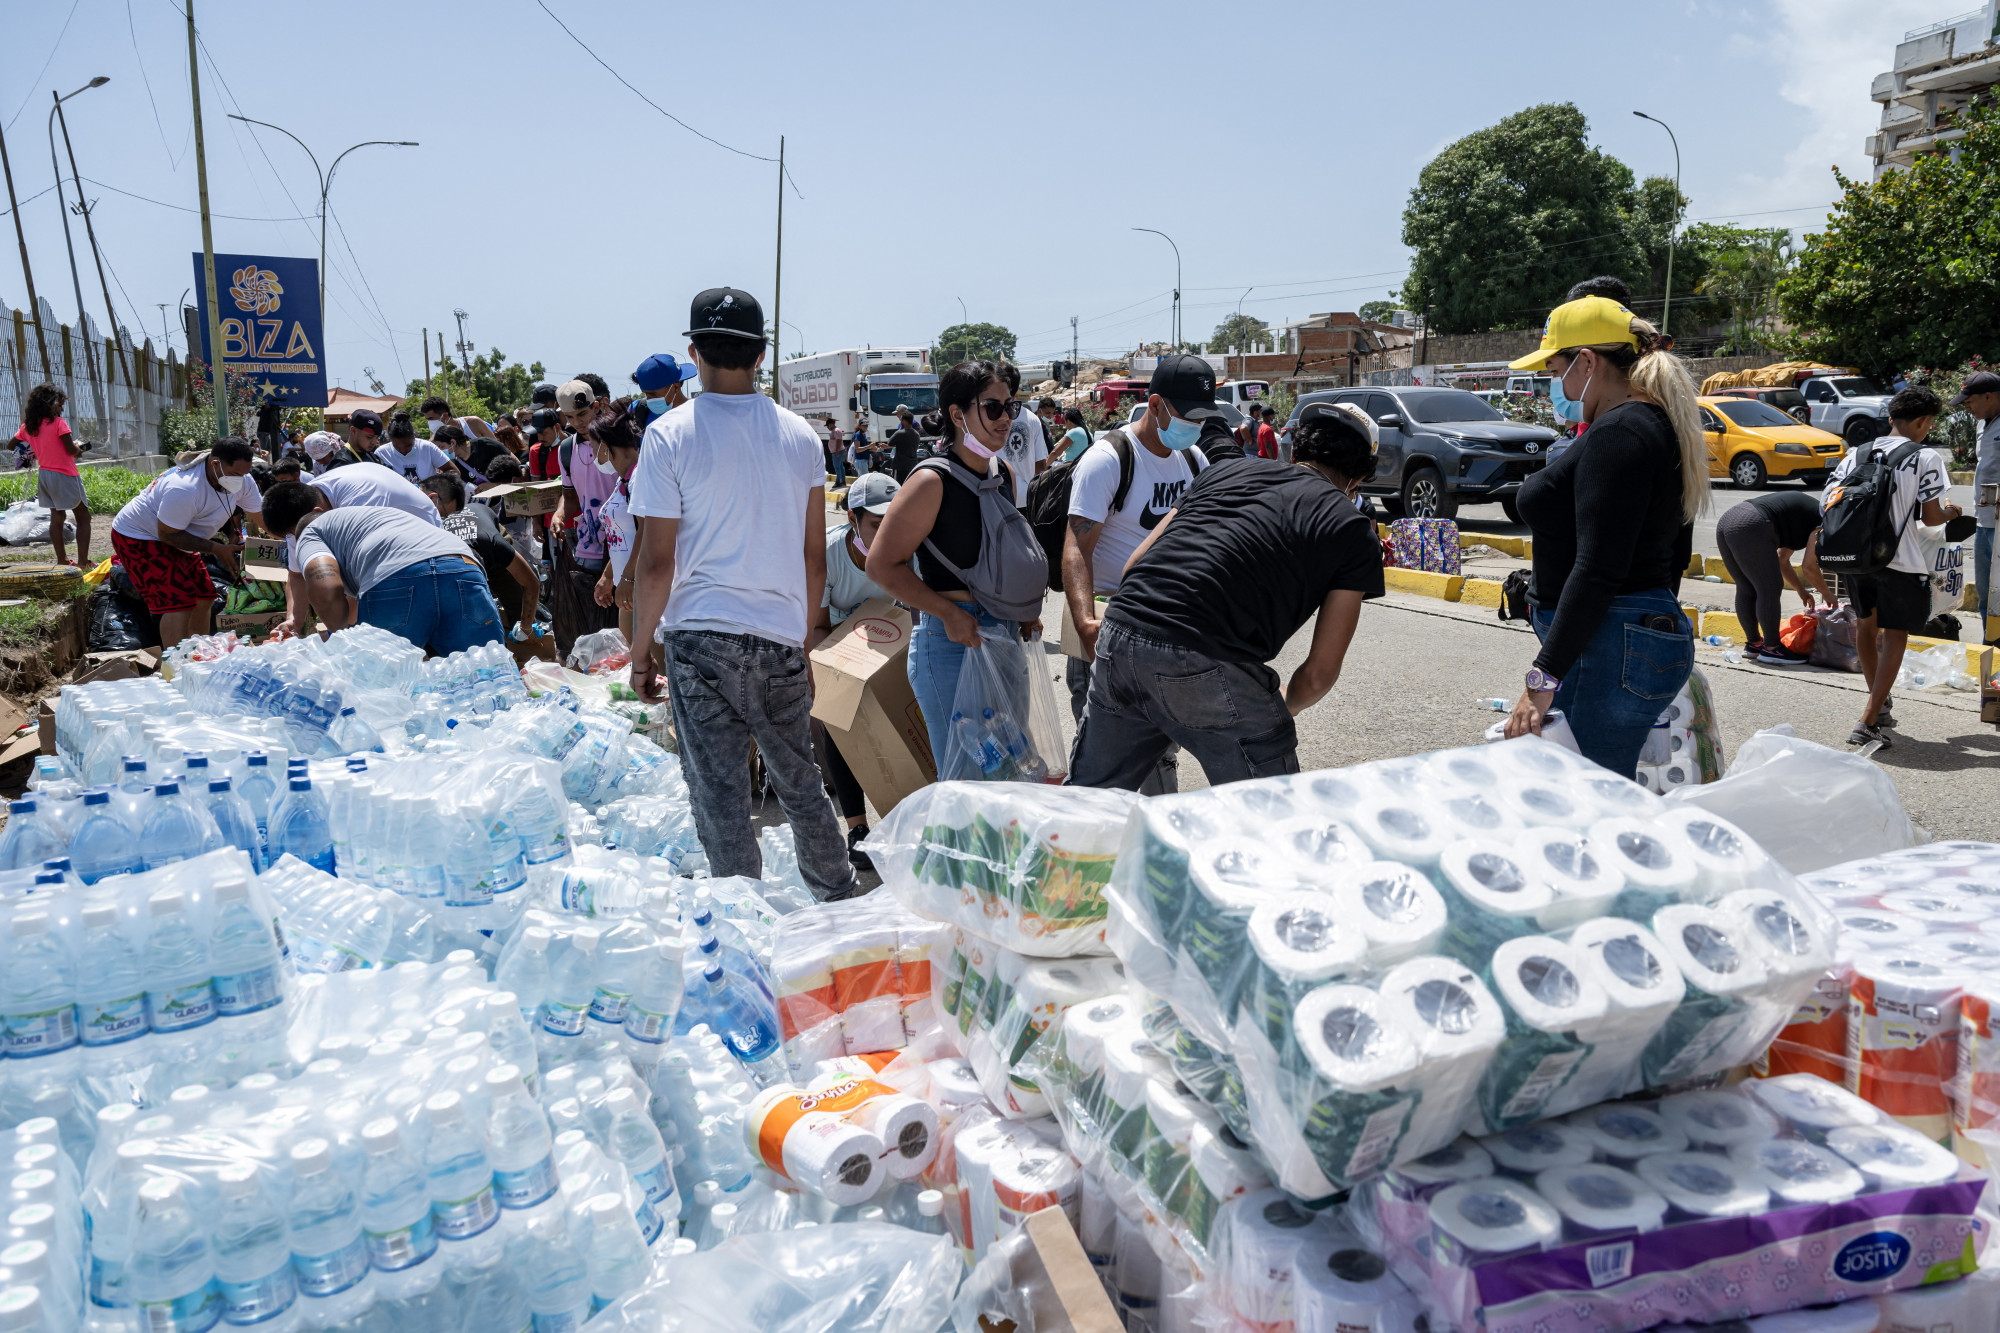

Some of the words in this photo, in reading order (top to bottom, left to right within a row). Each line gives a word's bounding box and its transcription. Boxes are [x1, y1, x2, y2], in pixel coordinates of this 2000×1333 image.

[1820, 554, 1856, 562] GATORADE
[868, 625, 894, 639] PAMPA
[174, 1002, 209, 1020] GLACIER
[104, 1016, 141, 1033] GLACIER
[1841, 1247, 1901, 1275] ALISOF
